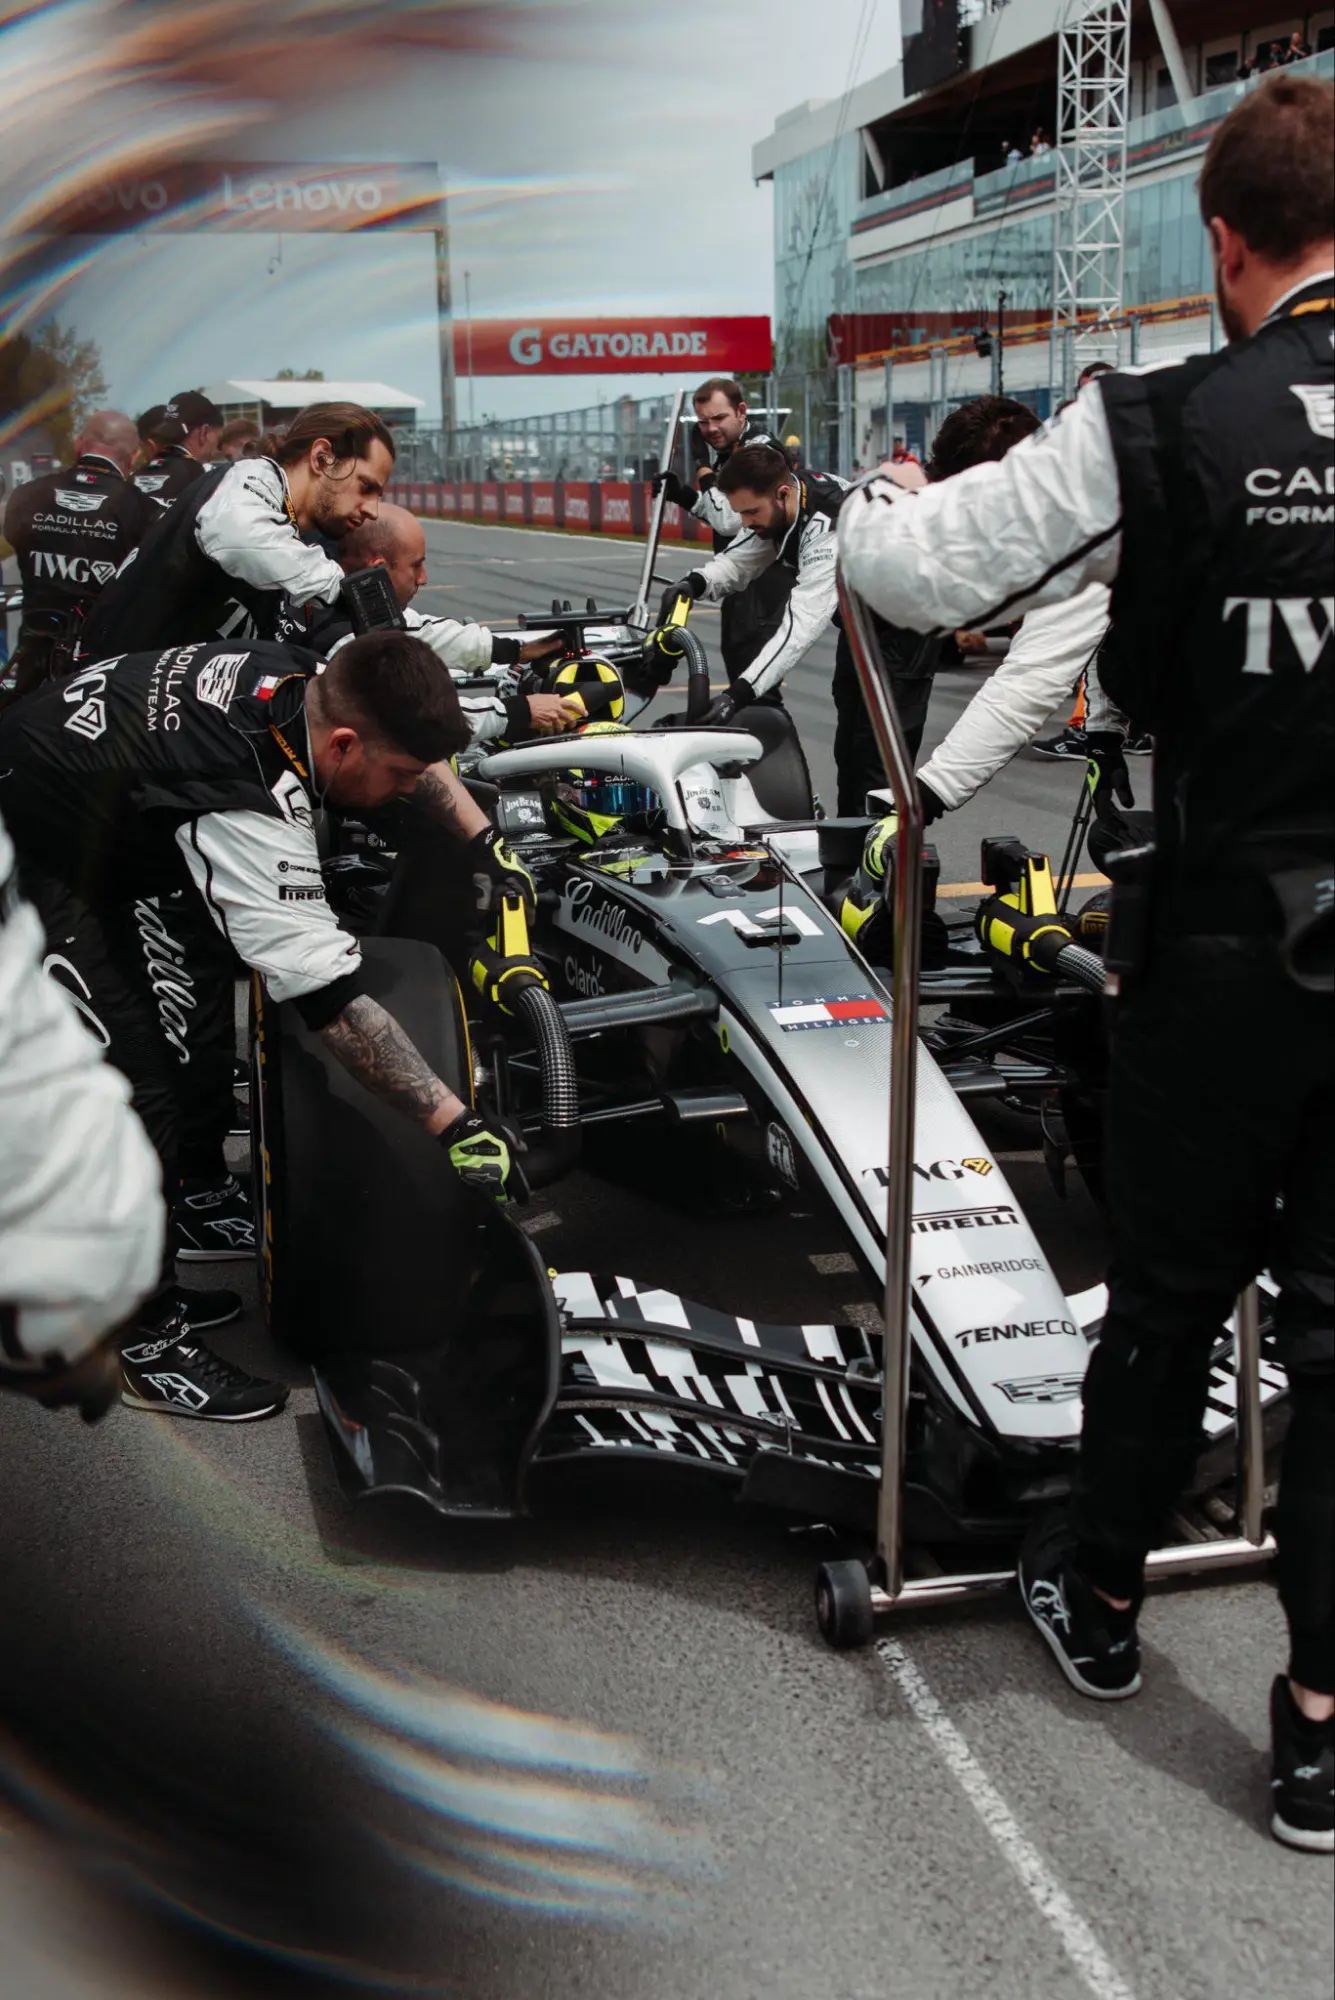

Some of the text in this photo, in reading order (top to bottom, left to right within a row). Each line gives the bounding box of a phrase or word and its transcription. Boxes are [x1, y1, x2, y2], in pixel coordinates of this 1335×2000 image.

[221, 175, 383, 212] Lenovo
[508, 327, 708, 366] G GATORADE
[31, 523, 79, 536] FORMULA
[88, 529, 117, 541] TEAM
[33, 512, 119, 533] CADILLAC
[29, 551, 91, 583] TWG
[163, 642, 207, 732] ADILLAC
[146, 686, 159, 732] TEAM
[565, 877, 643, 954] Cadillac
[696, 906, 825, 936] 11
[772, 994, 869, 1008] TOMMY
[787, 1016, 887, 1031] HILFIGER
[937, 1258, 1047, 1280] GAINBRIDGE
[954, 1319, 1078, 1350] TENNECO
